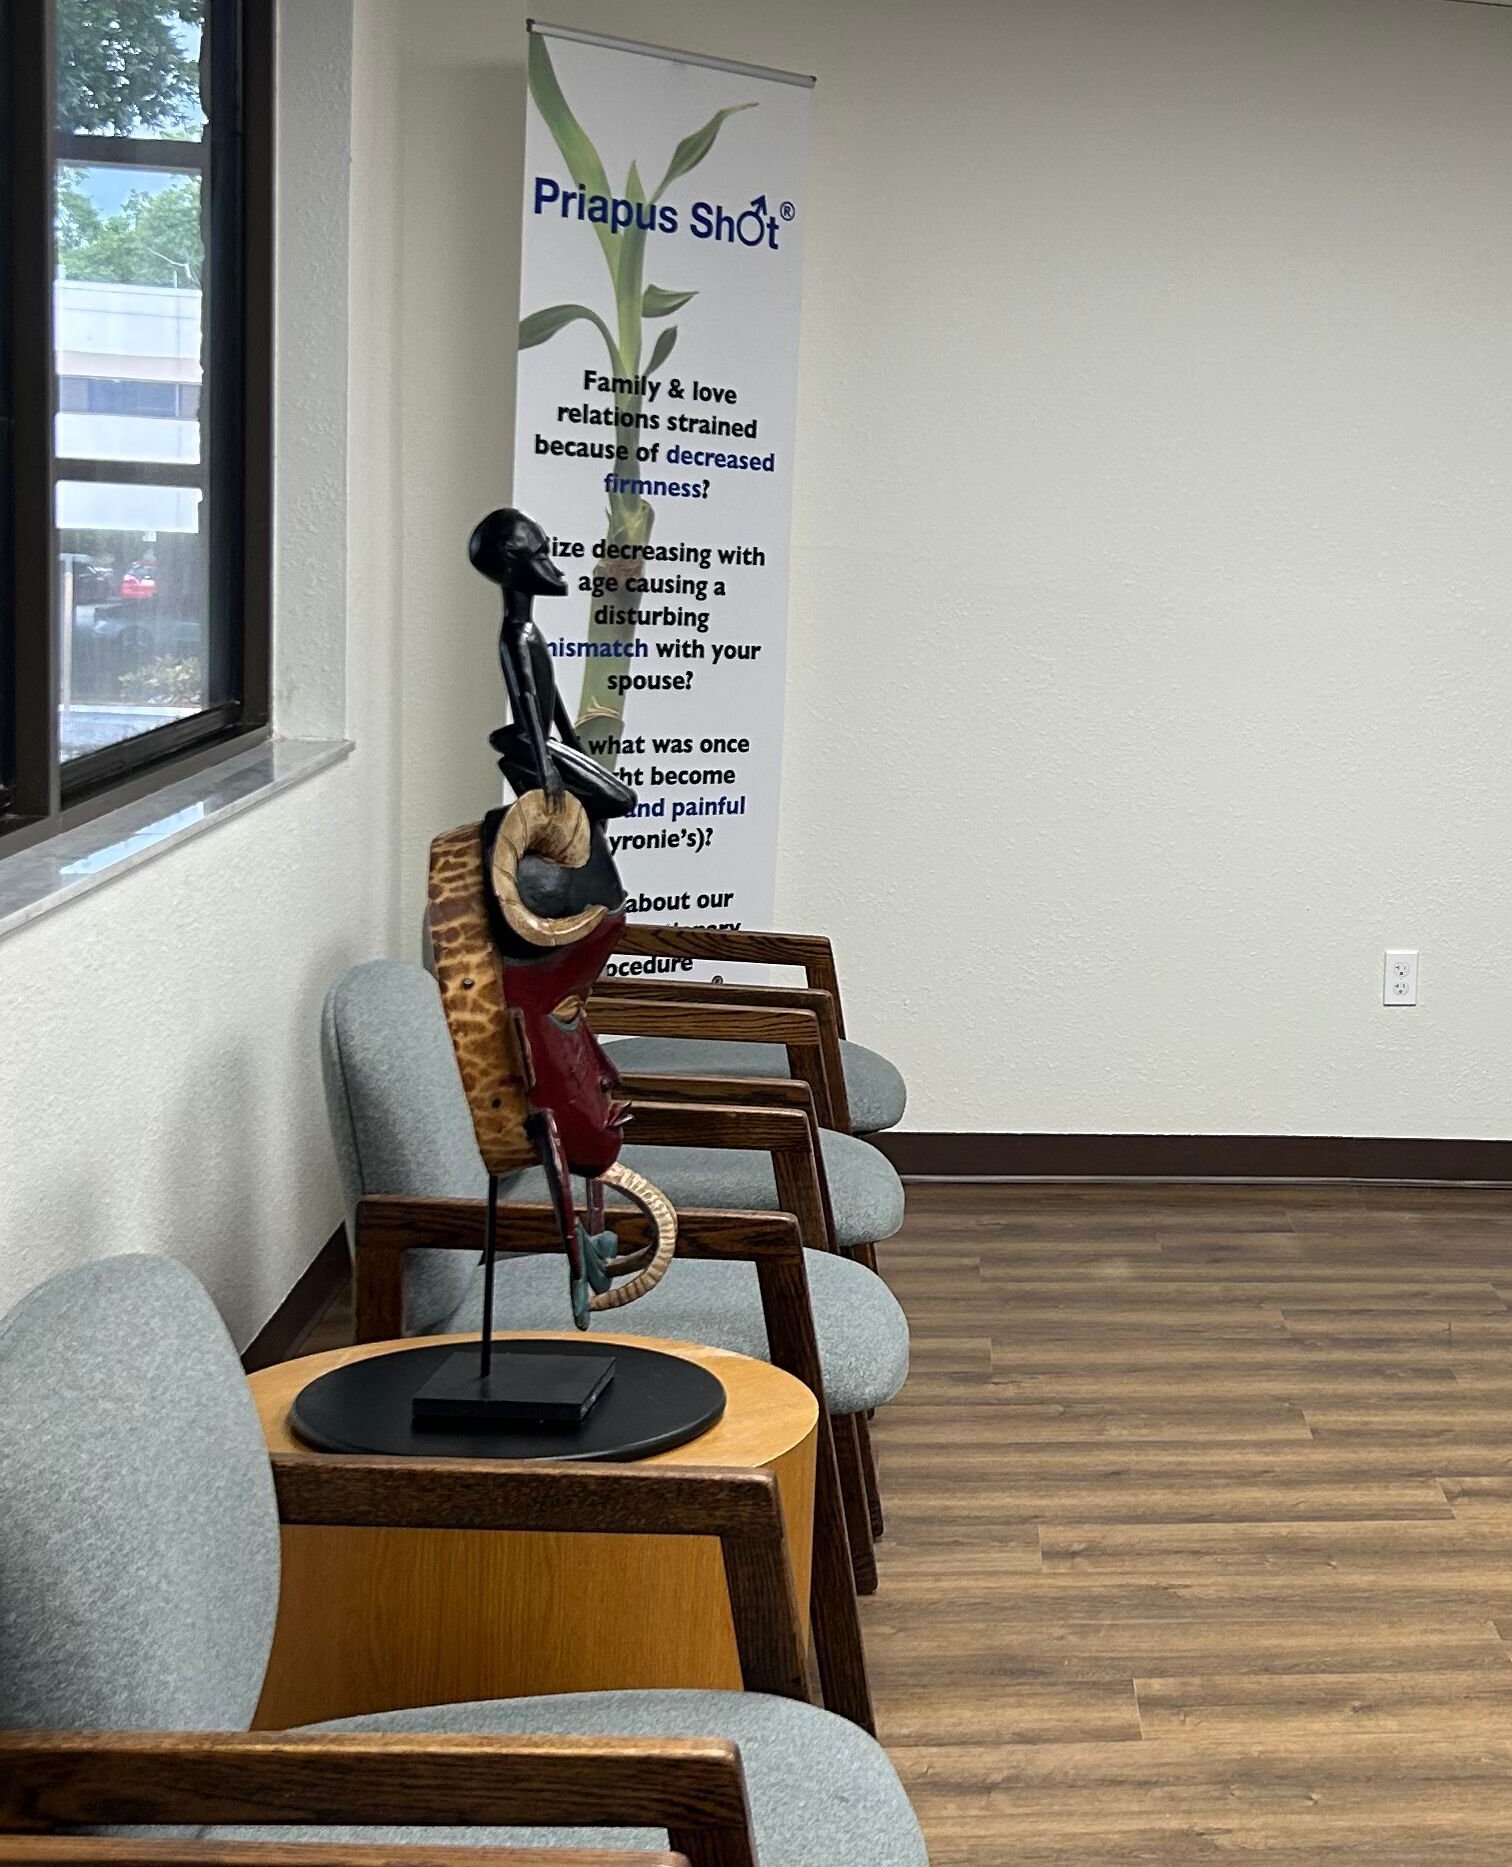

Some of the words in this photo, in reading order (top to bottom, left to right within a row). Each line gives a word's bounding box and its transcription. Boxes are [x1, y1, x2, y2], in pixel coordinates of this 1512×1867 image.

[534, 177, 678, 234] Priapus
[584, 370, 661, 402] Family
[668, 378, 685, 400] &
[693, 381, 737, 404] love
[557, 403, 660, 430] relations
[667, 414, 758, 439] strained
[534, 434, 629, 461] because
[636, 443, 660, 463] of
[666, 445, 775, 472] decreased
[604, 473, 711, 499] firmness?
[551, 536, 585, 558] ize
[592, 539, 712, 569] decreasing
[718, 545, 766, 566] with
[578, 576, 618, 597] age
[625, 575, 709, 601] causing
[714, 580, 726, 596] a
[594, 605, 710, 633] disturbing
[656, 639, 705, 659] with
[711, 643, 762, 665] your
[607, 671, 694, 696] spouse?
[588, 735, 646, 755] what
[652, 738, 694, 754] was
[700, 737, 750, 753] once
[650, 766, 736, 786] become
[671, 796, 746, 822] painful
[609, 828, 714, 855] yronie's)?
[625, 892, 691, 913] about
[697, 892, 734, 909] our
[606, 956, 693, 977] ocedure
